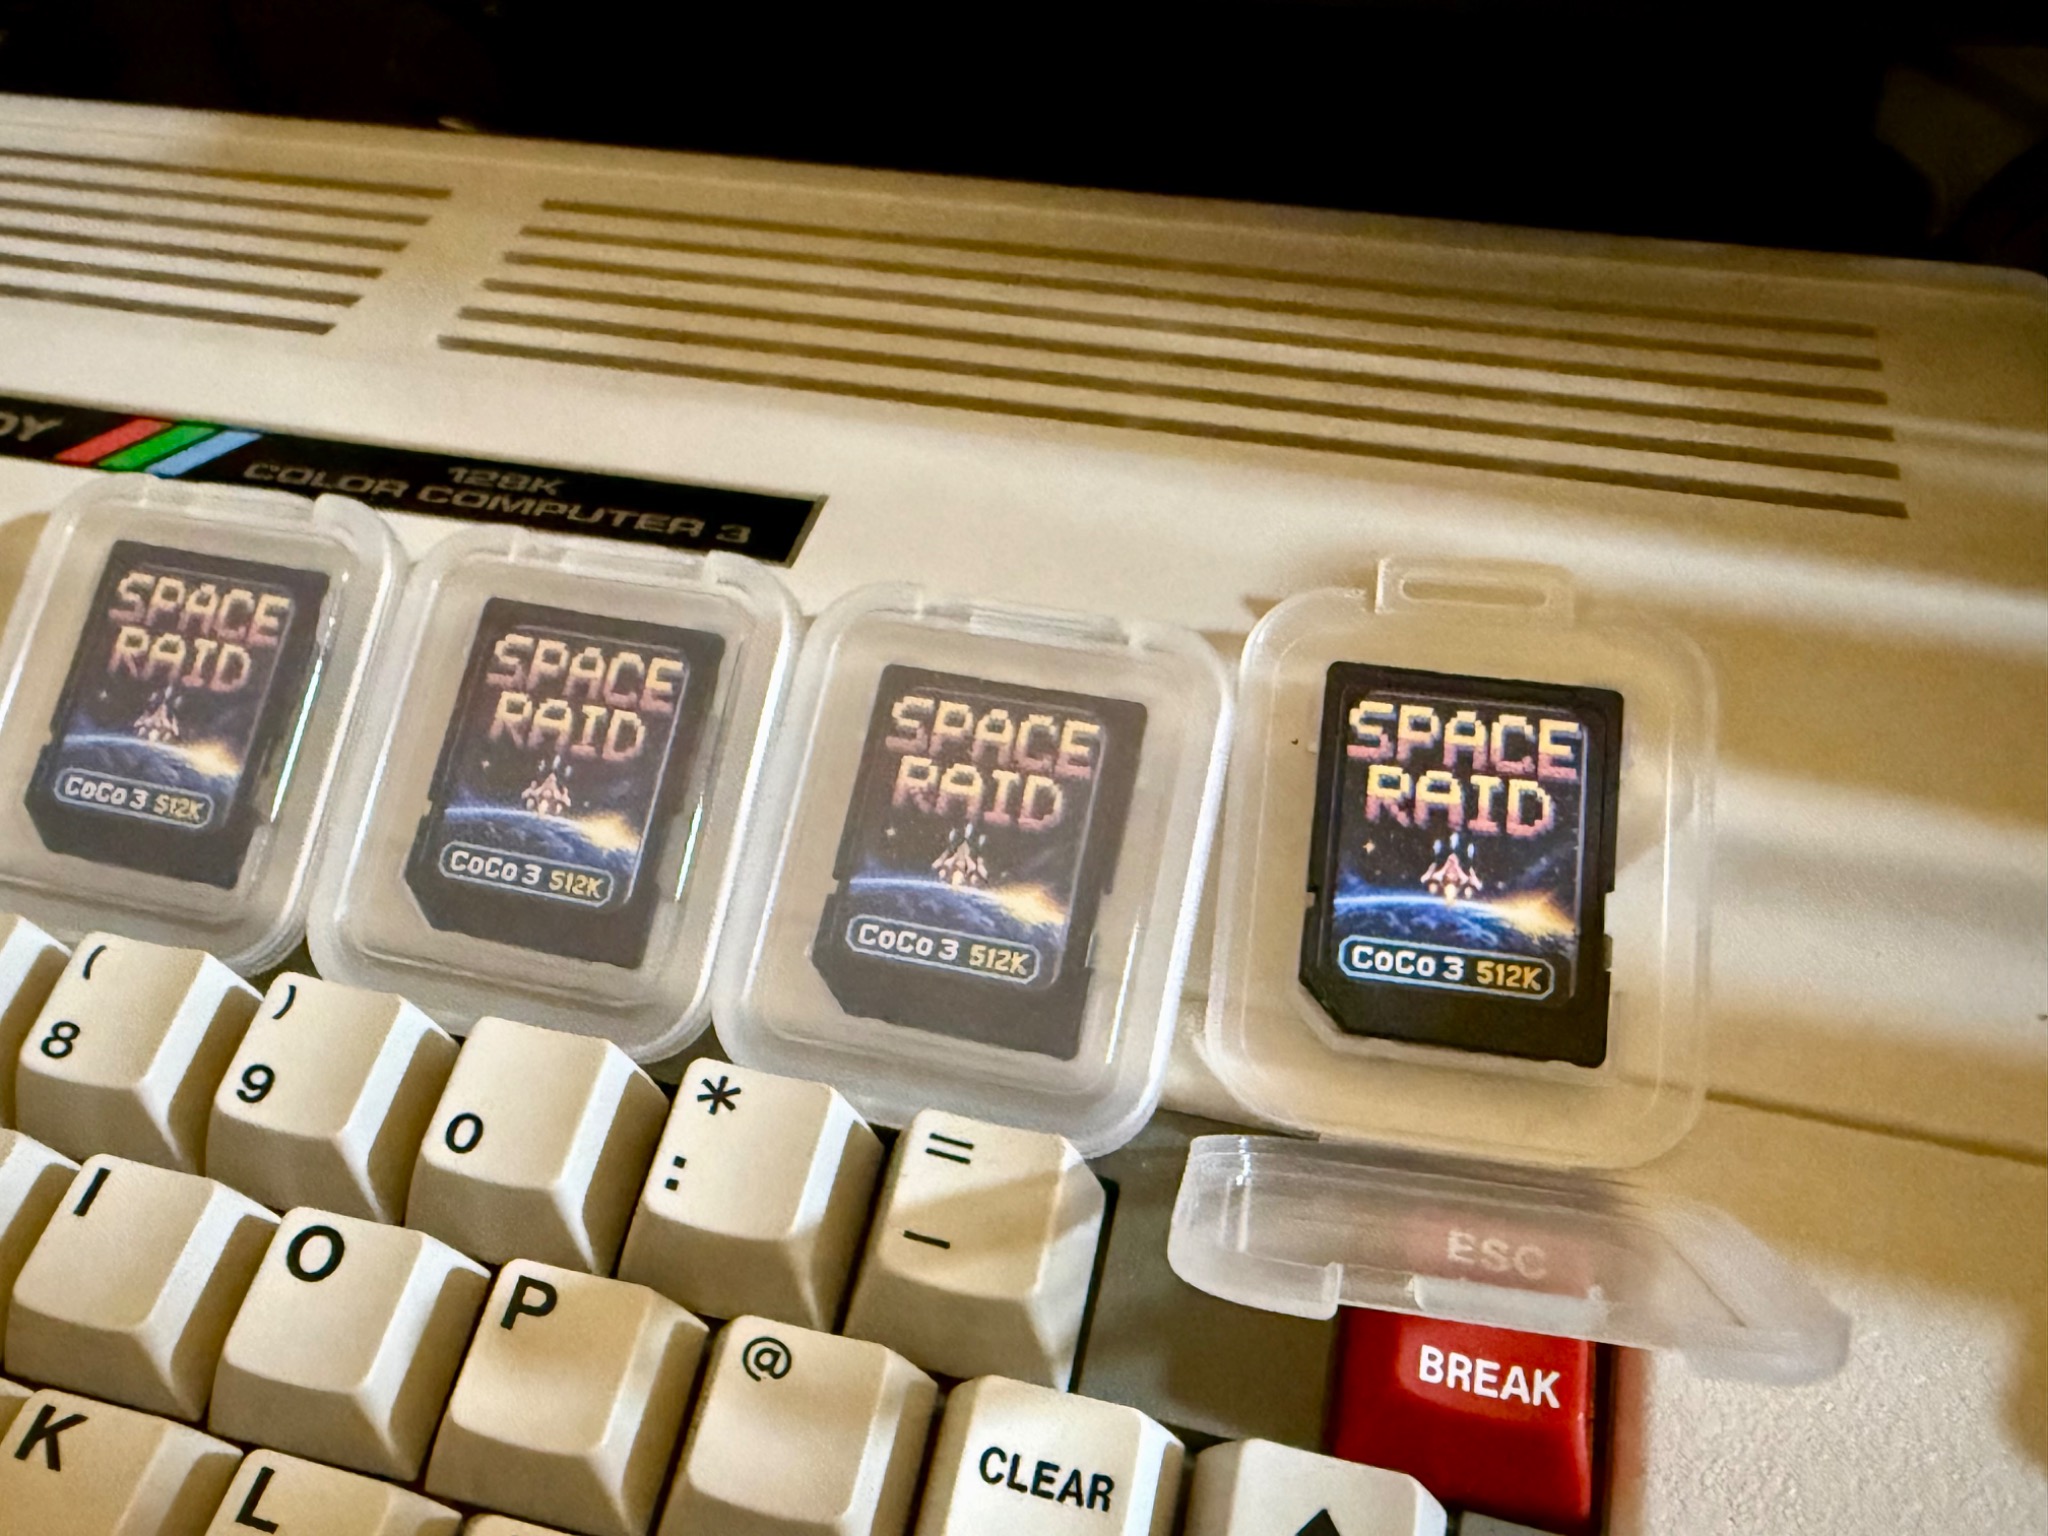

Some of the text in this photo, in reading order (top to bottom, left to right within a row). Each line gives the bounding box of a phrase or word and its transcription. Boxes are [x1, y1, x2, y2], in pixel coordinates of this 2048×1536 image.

[244, 463, 751, 544] COLOR COMPUTER 3
[449, 466, 564, 495] 128K
[108, 571, 291, 647] SPACE
[107, 625, 252, 693] RAID
[486, 633, 685, 715] SPACE
[488, 691, 646, 762] RAID
[885, 695, 1101, 780] SPACE
[1346, 700, 1582, 781] SPACE
[892, 755, 1063, 832] RAID
[1365, 764, 1555, 839] RAID
[450, 850, 605, 899] CoCo 3 512K
[858, 922, 1030, 976] CoCo 3 512K
[1351, 945, 1542, 992] CoCo 3 512K
[40, 1021, 80, 1059] 8
[236, 1064, 276, 1103] 9
[73, 1167, 110, 1217] I
[286, 1225, 345, 1282] O
[1446, 1228, 1547, 1281] ESC
[500, 1274, 557, 1330] P
[742, 1336, 792, 1382] @
[1418, 1343, 1560, 1410] BREAK
[14, 1403, 88, 1471] K
[235, 1466, 279, 1534] L
[978, 1446, 1115, 1512] CLEAR
